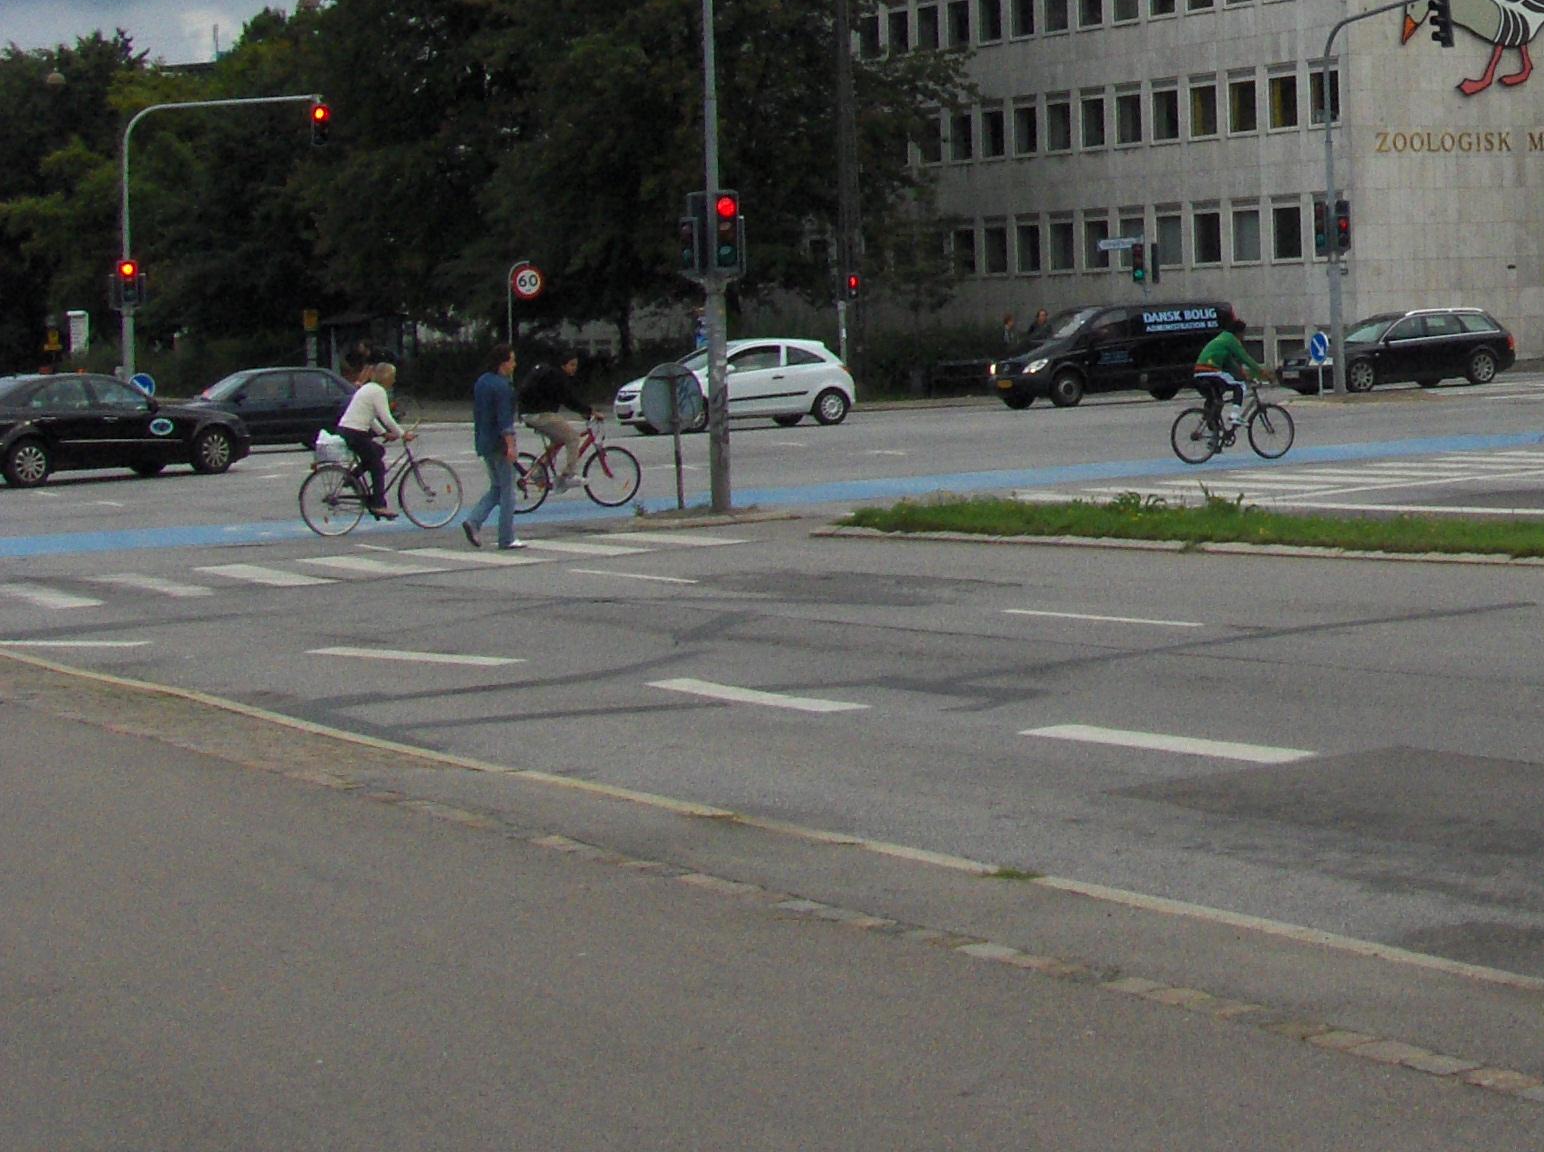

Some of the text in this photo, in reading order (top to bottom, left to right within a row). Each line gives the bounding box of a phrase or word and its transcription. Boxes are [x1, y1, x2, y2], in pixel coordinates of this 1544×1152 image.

[1375, 131, 1511, 153] ZOOLOGISK
[518, 274, 538, 287] 60
[1143, 308, 1217, 323] DANSK BOLIG
